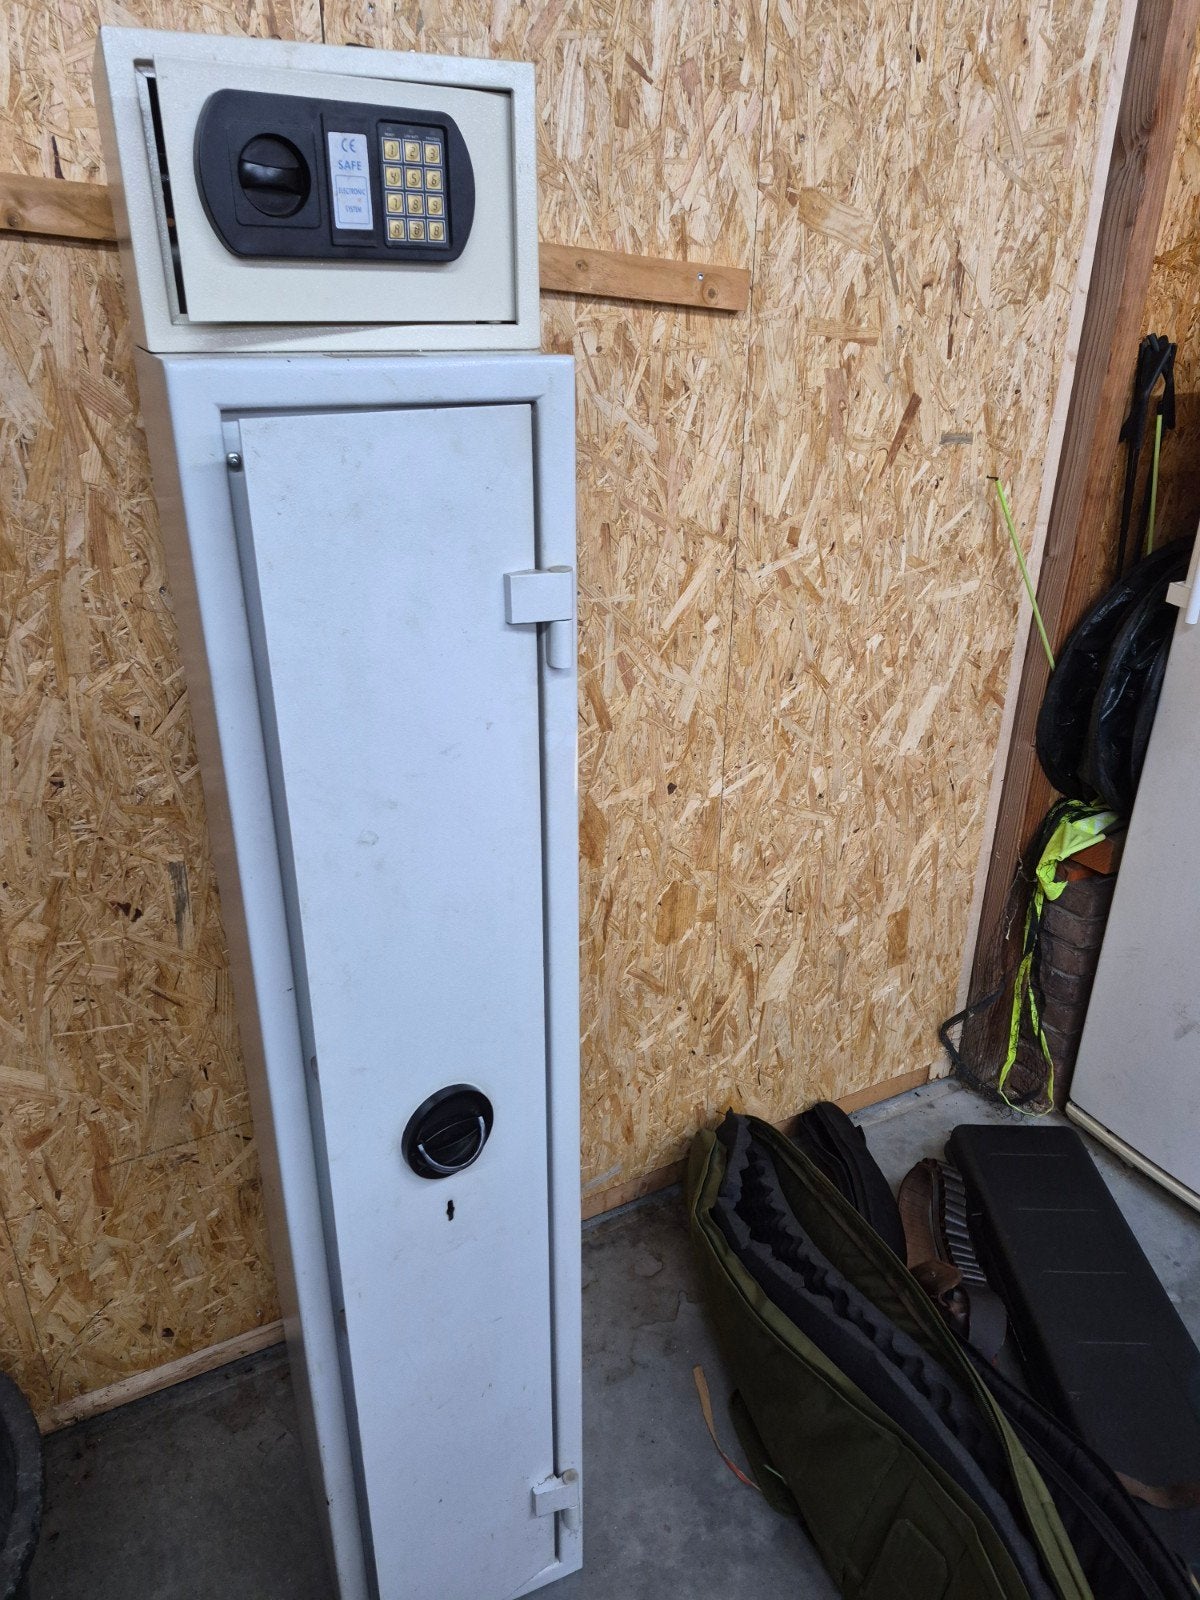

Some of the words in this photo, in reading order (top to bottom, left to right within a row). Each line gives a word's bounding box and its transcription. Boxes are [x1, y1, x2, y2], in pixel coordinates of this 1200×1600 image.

[409, 146, 416, 157] 2
[430, 147, 436, 159] 3
[337, 159, 362, 171] SAFE
[390, 172, 397, 183] 4
[411, 173, 417, 184] 5
[431, 174, 438, 185] 6
[338, 187, 366, 196] ELECTRONIC
[345, 204, 362, 213] SYSTEM
[412, 199, 419, 210] 8
[432, 200, 438, 211] 9
